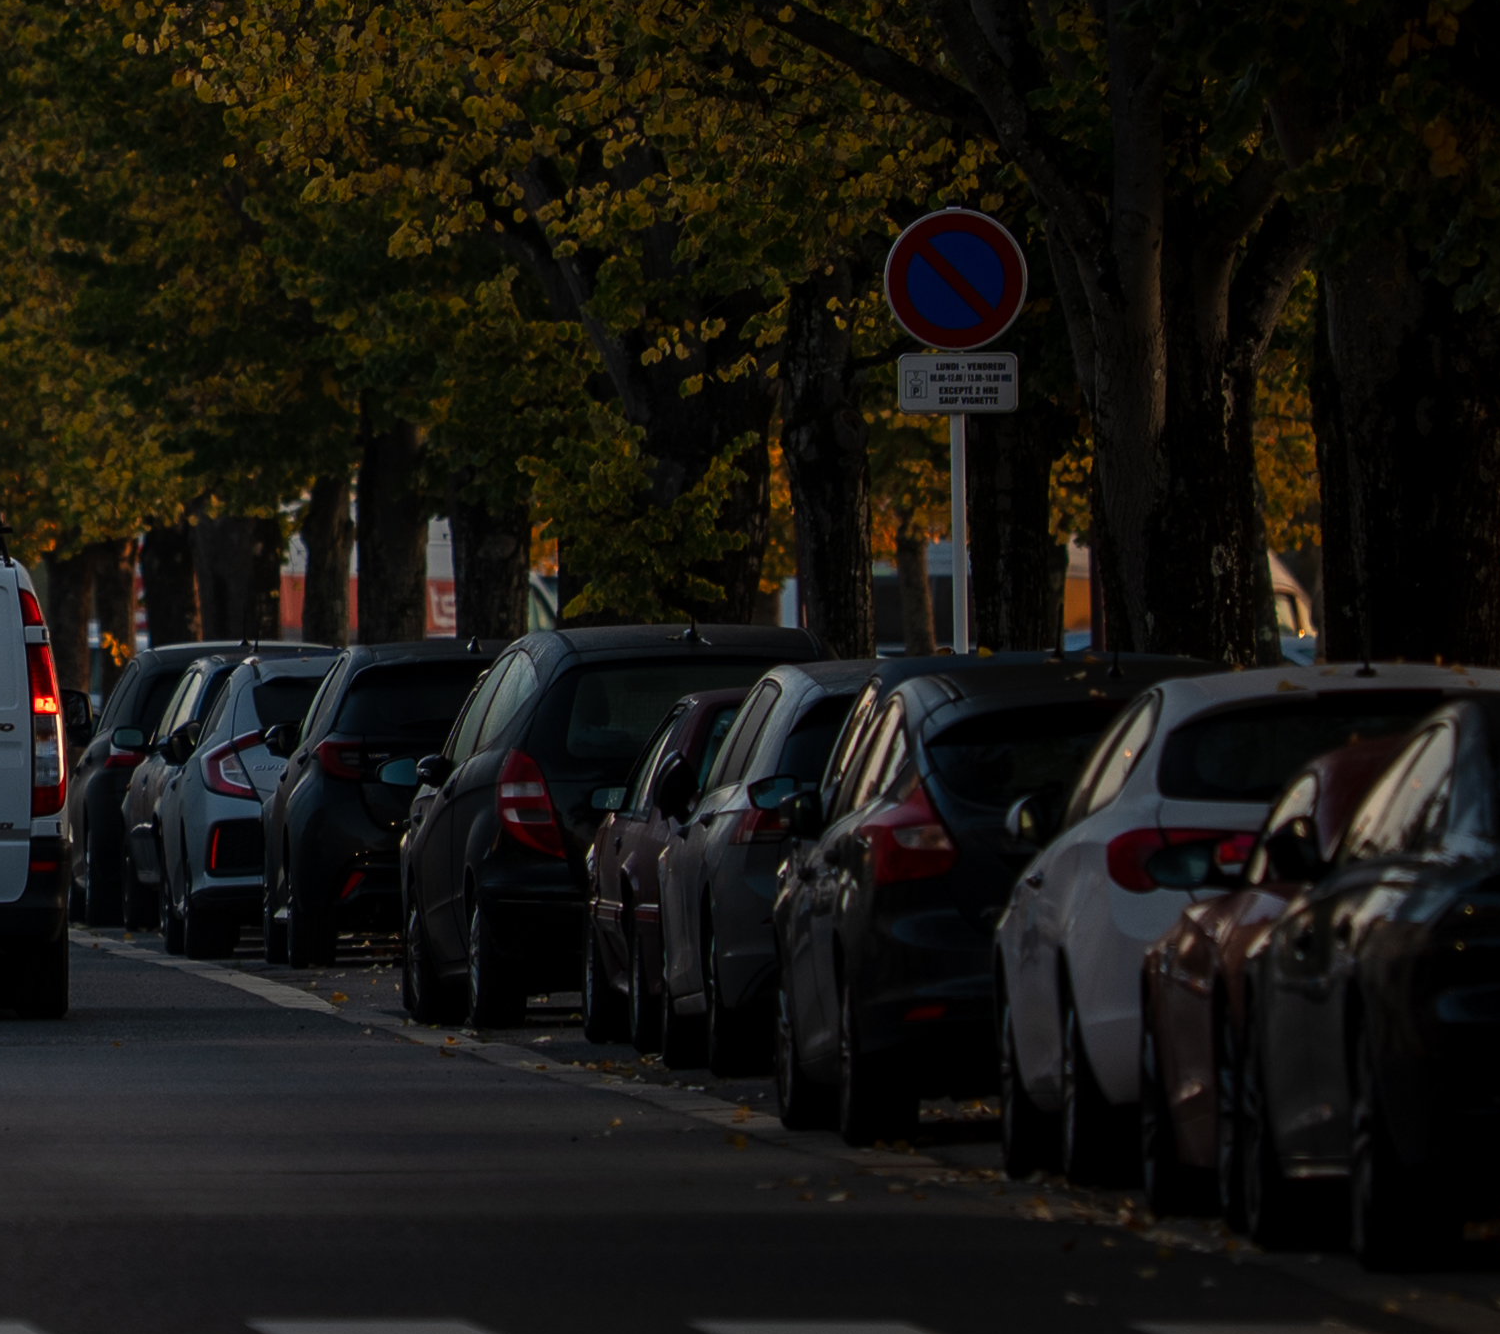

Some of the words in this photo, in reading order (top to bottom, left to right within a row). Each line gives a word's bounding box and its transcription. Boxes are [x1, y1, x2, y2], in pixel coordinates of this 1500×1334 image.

[936, 362, 960, 371] LUNDI
[967, 362, 1006, 371] VENDREDI
[939, 384, 973, 395] EXCEPTÉ
[975, 386, 981, 395] 2
[982, 386, 999, 395] HRS
[938, 396, 959, 405] SAUF
[961, 396, 999, 405] VIGNETTE
